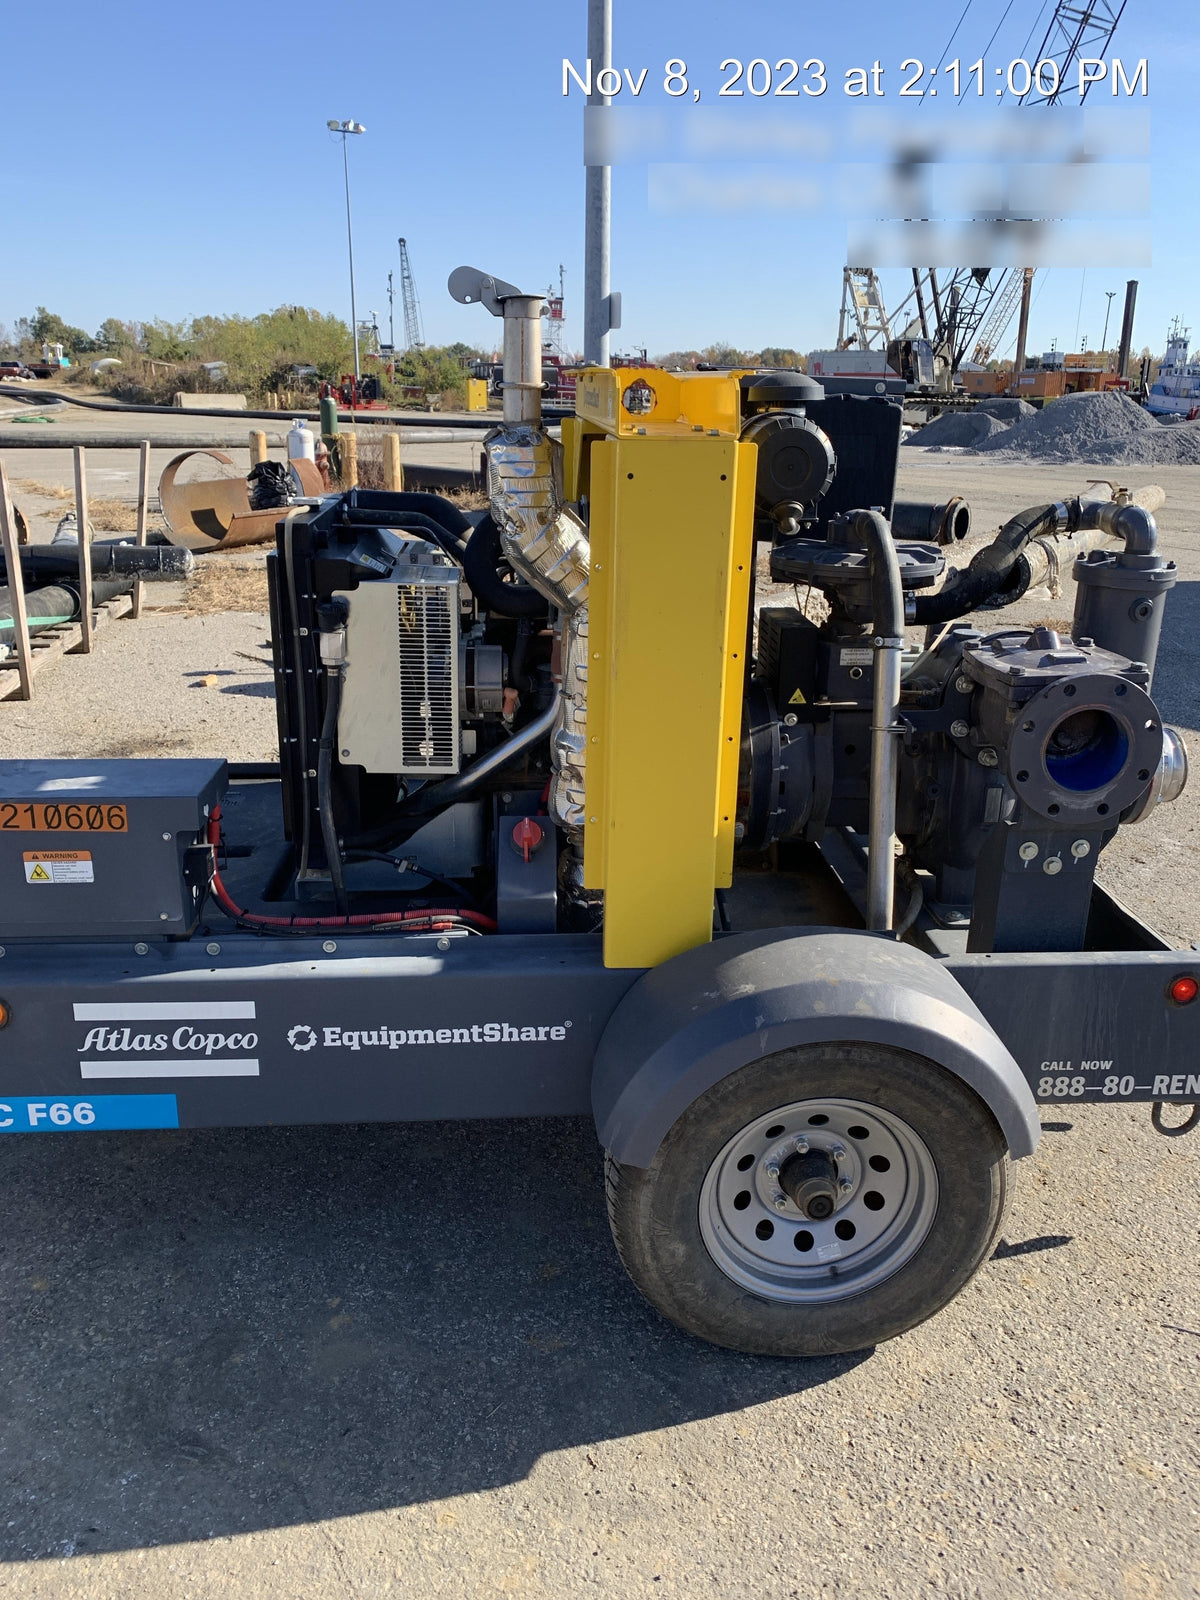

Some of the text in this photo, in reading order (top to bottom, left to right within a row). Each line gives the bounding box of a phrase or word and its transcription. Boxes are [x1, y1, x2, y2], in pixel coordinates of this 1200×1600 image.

[1, 804, 125, 830] 210606
[41, 852, 79, 860] WARNING
[77, 1025, 259, 1056] Atlas Copco
[1040, 1060, 1114, 1071] CALL NOW
[27, 1103, 96, 1126] F66
